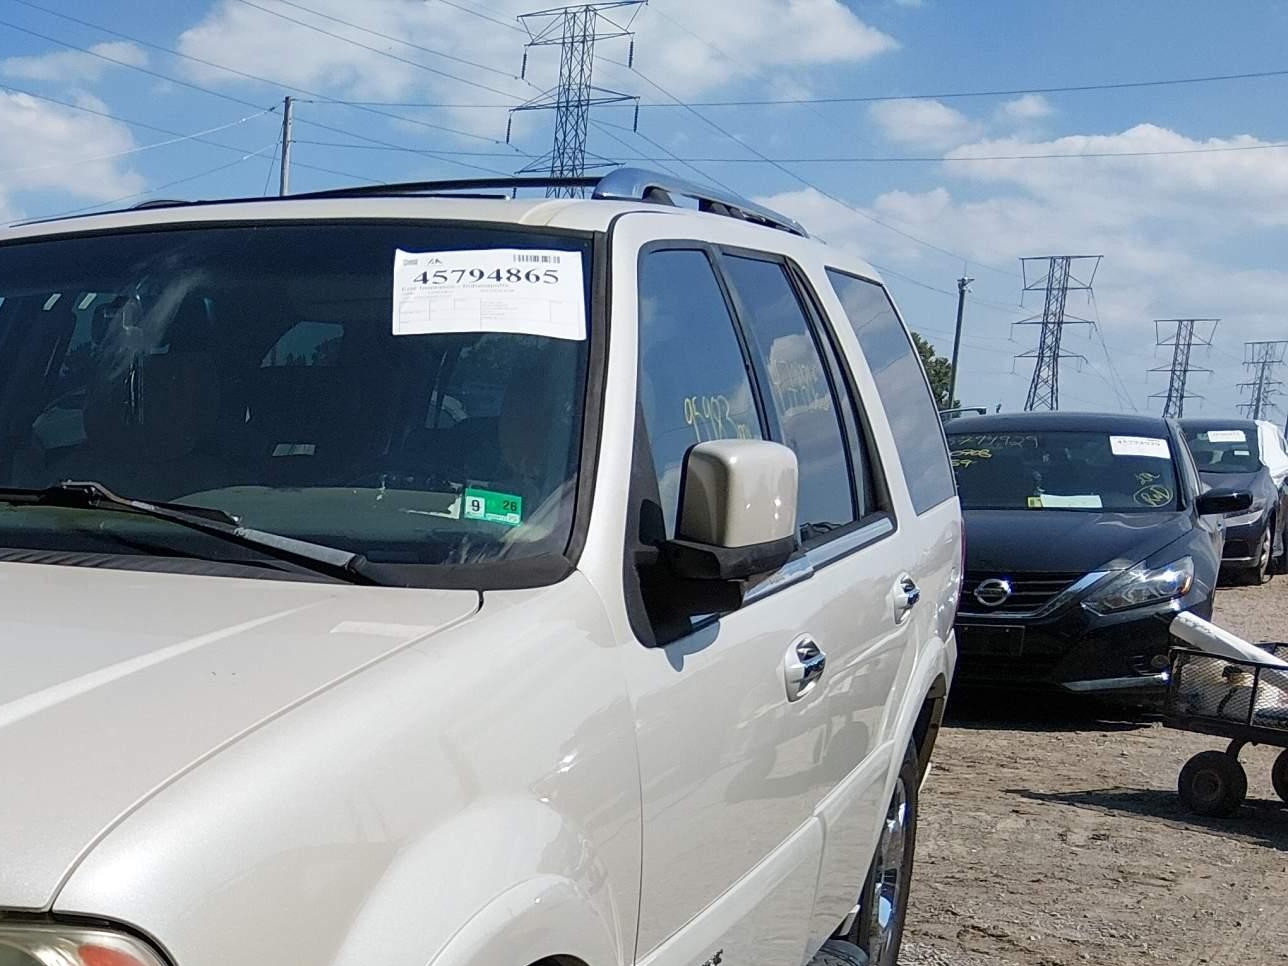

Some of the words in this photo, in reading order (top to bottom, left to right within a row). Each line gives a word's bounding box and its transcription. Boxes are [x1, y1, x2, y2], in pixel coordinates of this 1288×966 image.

[413, 268, 559, 284] 45794865
[472, 500, 480, 512] 9
[503, 500, 517, 512] 26
